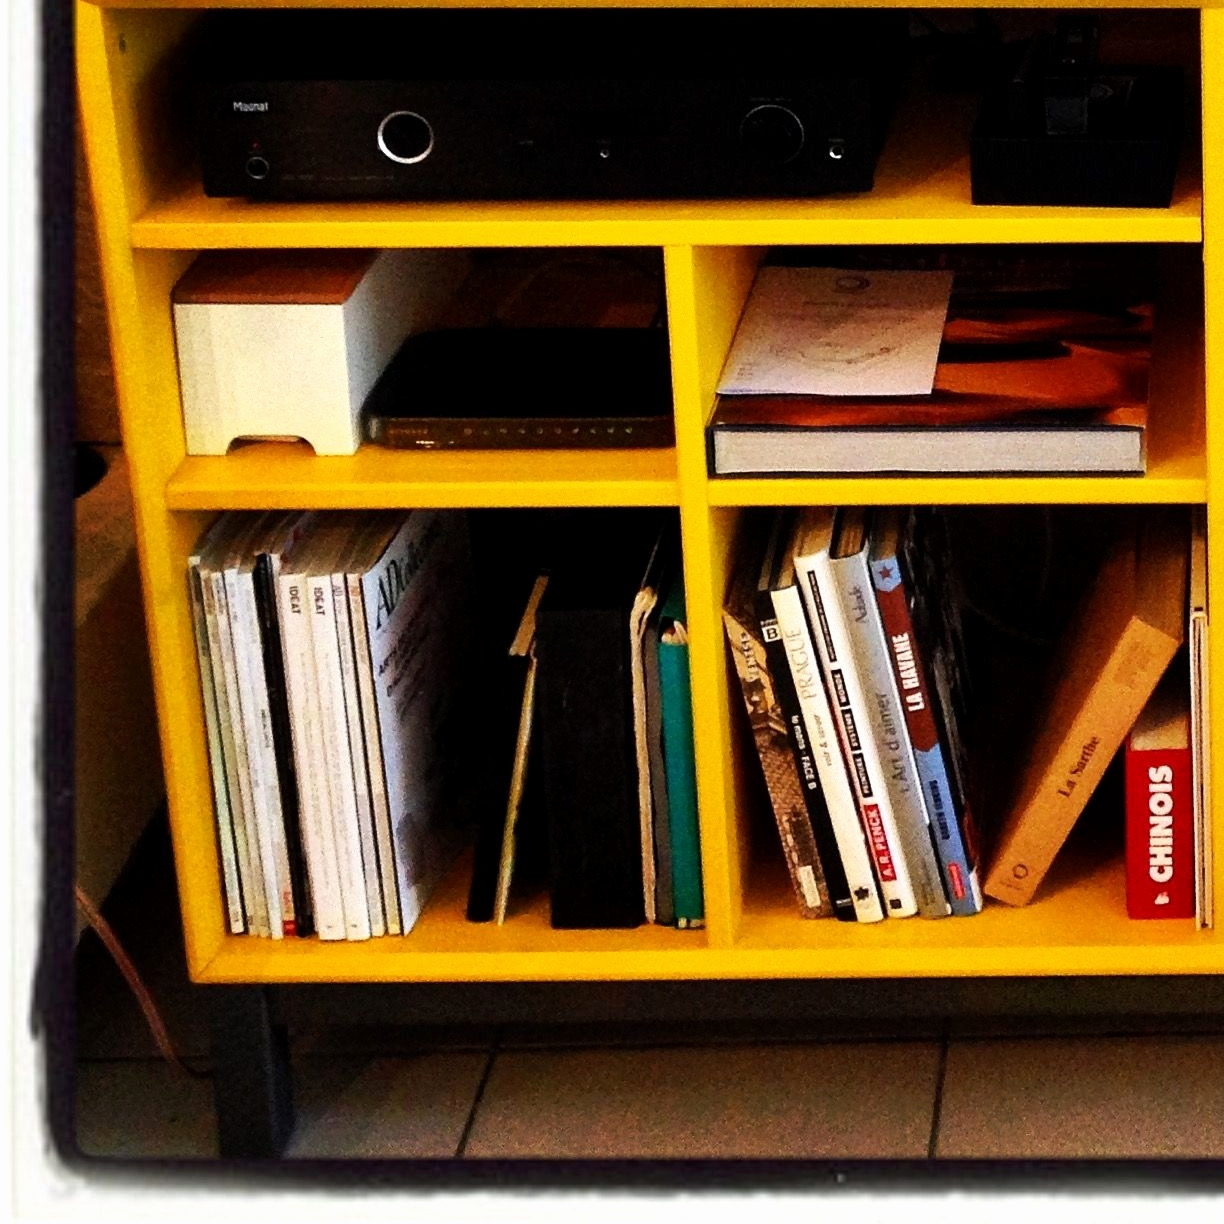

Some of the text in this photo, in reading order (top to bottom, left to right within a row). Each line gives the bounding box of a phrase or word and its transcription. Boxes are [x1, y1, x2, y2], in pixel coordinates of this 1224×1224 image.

[289, 585, 302, 615] IDEAT
[313, 586, 326, 615] IDEAT
[785, 630, 818, 701] PRAGUE
[891, 632, 925, 712] LA HAVANE
[800, 755, 815, 780] FACE
[1058, 735, 1101, 798] La Sarthe
[867, 808, 889, 851] PENCK
[1148, 764, 1174, 883] CHINOIS
